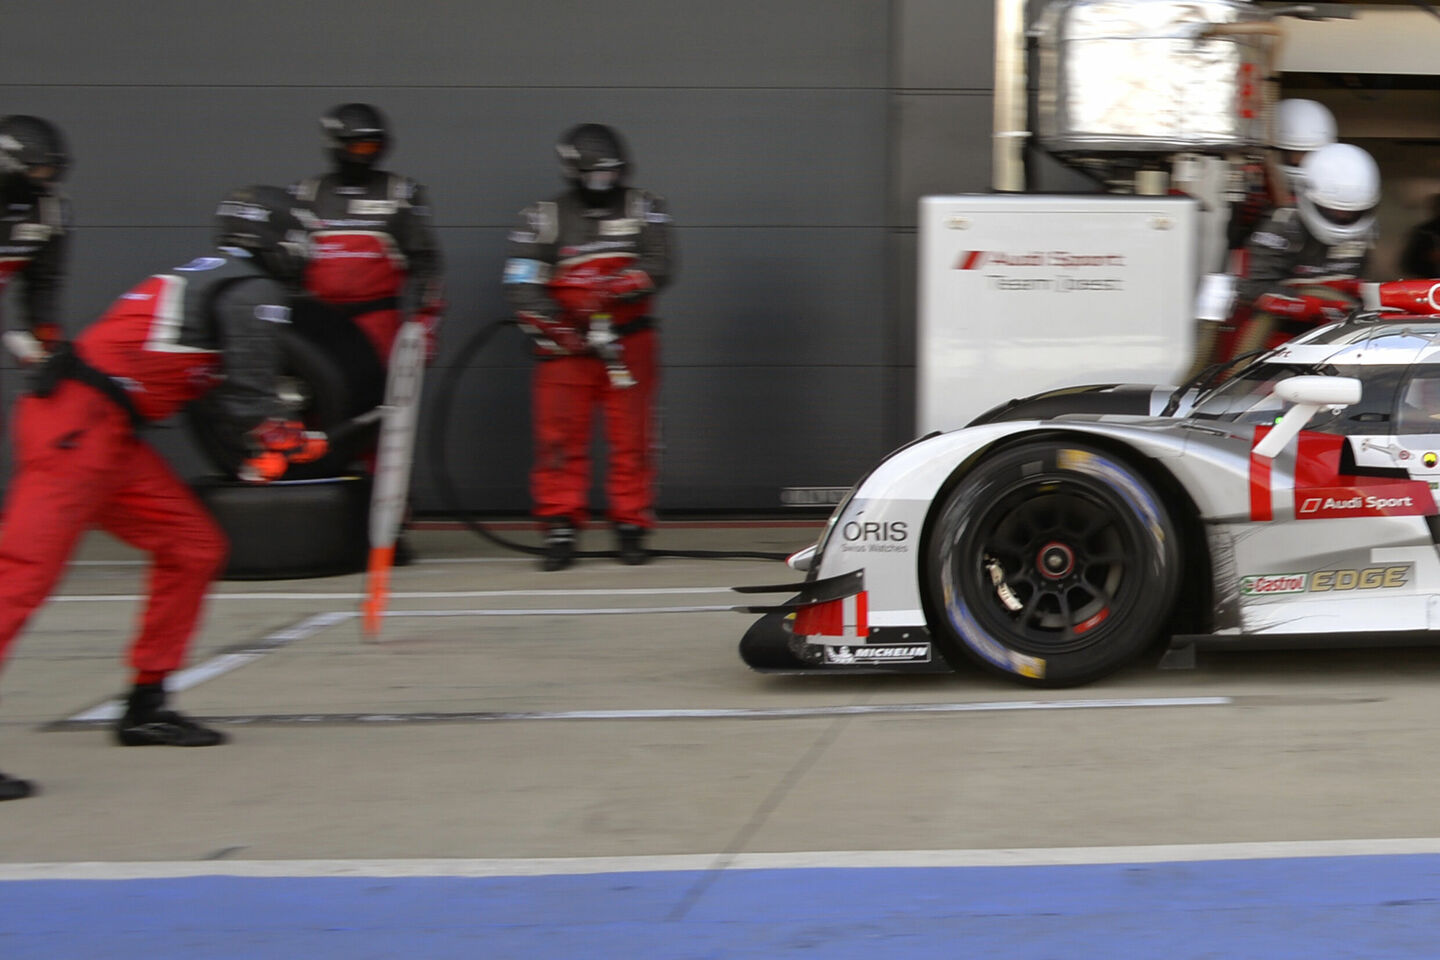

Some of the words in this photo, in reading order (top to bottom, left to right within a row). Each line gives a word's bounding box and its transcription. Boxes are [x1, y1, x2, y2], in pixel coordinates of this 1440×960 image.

[1047, 251, 1127, 269] Sport
[1323, 496, 1363, 510] Audi
[1365, 496, 1413, 510] Sport
[843, 521, 909, 542] ORIS
[1255, 575, 1304, 592] Castrol
[1309, 566, 1411, 593] EDGE
[854, 646, 929, 658] MICHELIN
